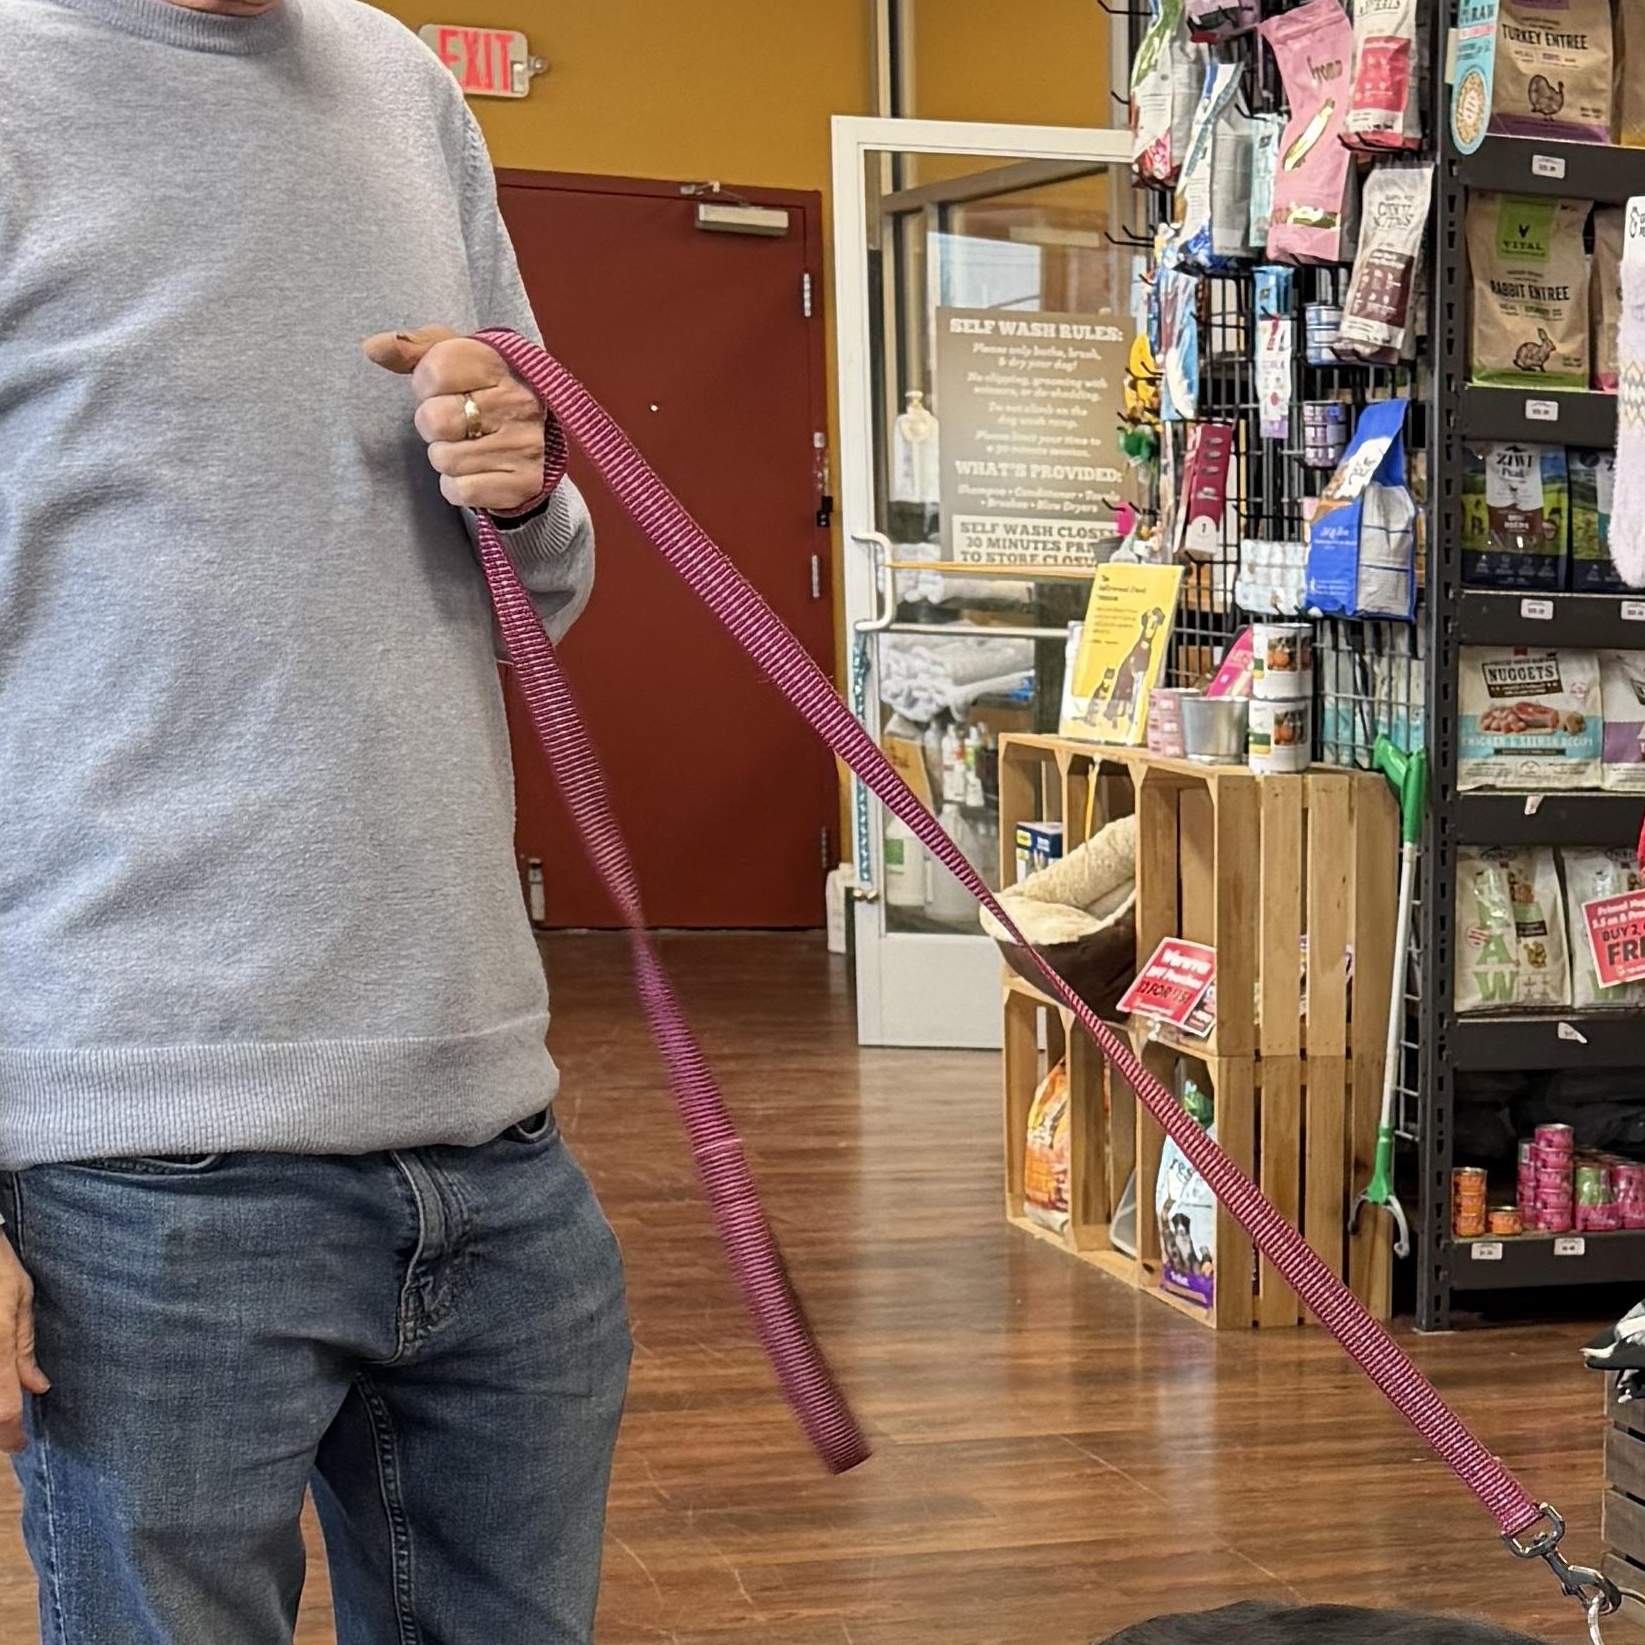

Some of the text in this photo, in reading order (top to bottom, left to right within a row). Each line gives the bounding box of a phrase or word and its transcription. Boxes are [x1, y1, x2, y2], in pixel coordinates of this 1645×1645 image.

[1501, 23, 1589, 51] TURKEY ENTREE
[437, 28, 514, 92] EXIT
[1502, 240, 1544, 251] VITAL
[1490, 280, 1570, 301] RABBIT ENTREE
[950, 318, 1124, 341] SELF WASH RULES:
[1496, 452, 1533, 468] ZIWI
[955, 460, 1124, 483] WHAT'S PROVIDED:
[1014, 487, 1077, 499] Conditioner
[960, 522, 1000, 534] SELF
[1003, 523, 1053, 537] WASH
[1486, 663, 1556, 683] NUGGETS
